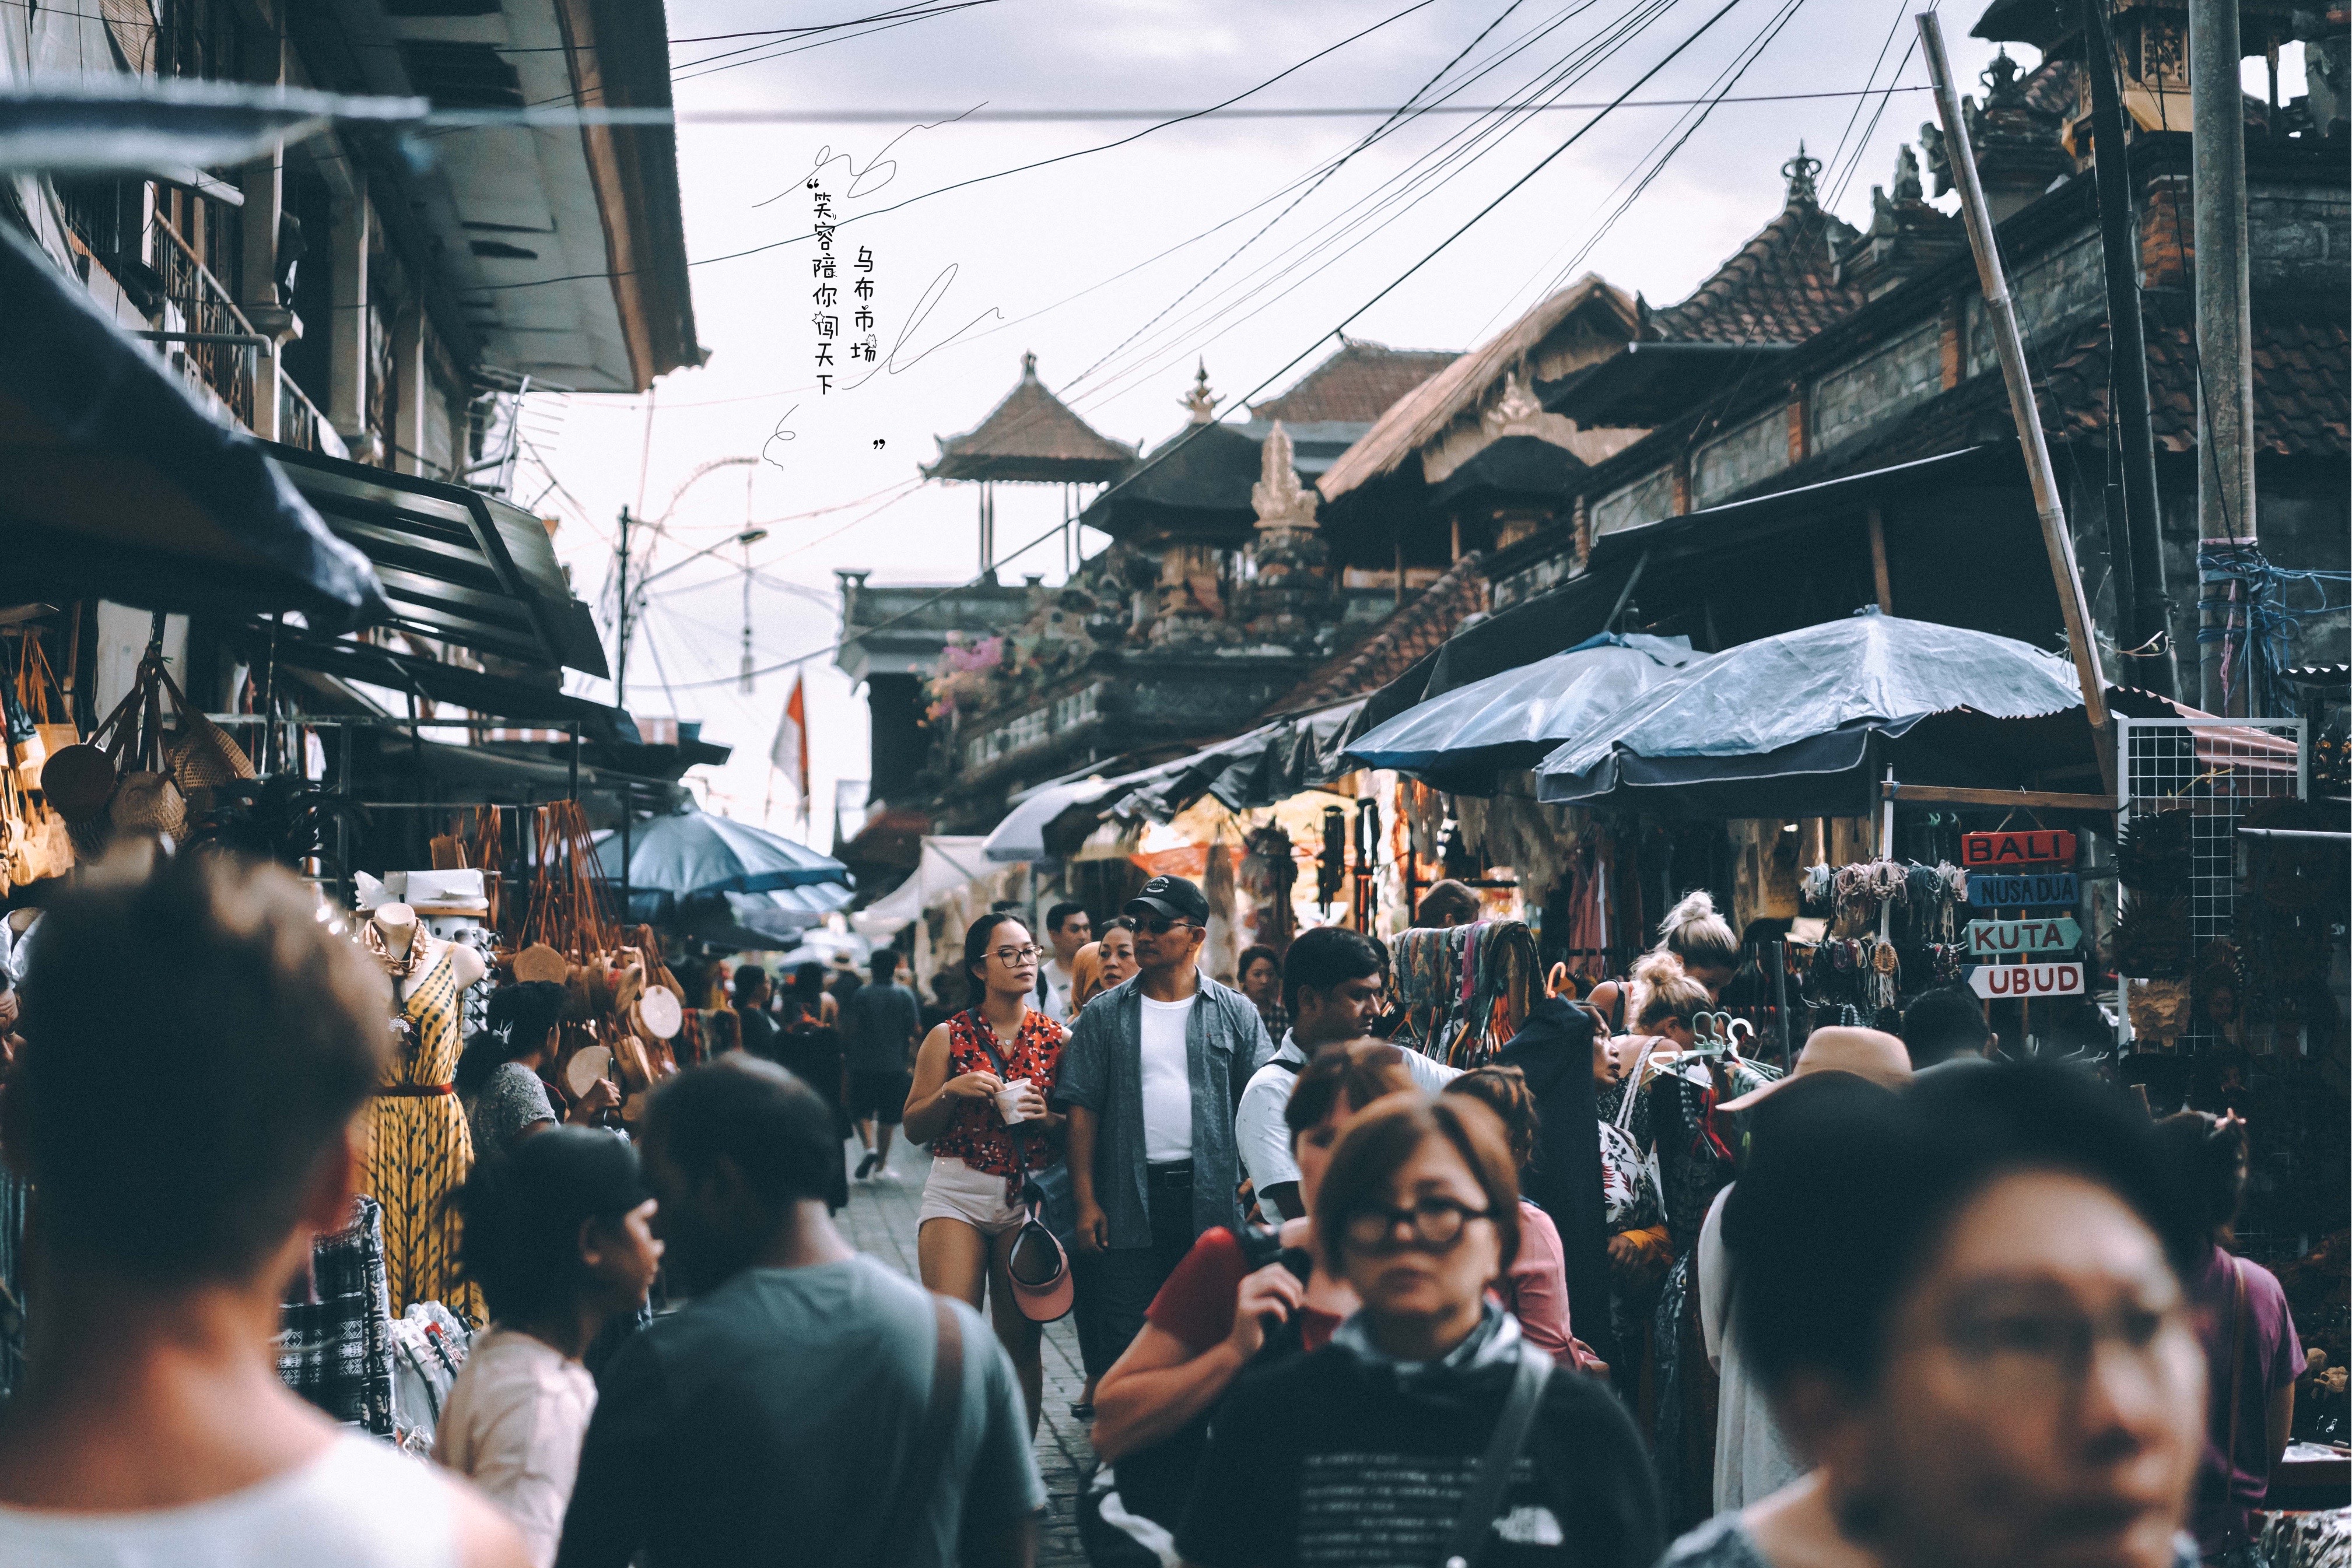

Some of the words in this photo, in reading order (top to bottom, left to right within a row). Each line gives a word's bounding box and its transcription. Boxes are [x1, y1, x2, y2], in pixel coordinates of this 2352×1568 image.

[1968, 834, 2060, 862] BALI
[1983, 879, 2034, 904] NUSA
[2036, 876, 2075, 903] DUA
[1975, 923, 2064, 950] KUTA
[1989, 966, 2078, 994] UBUD
